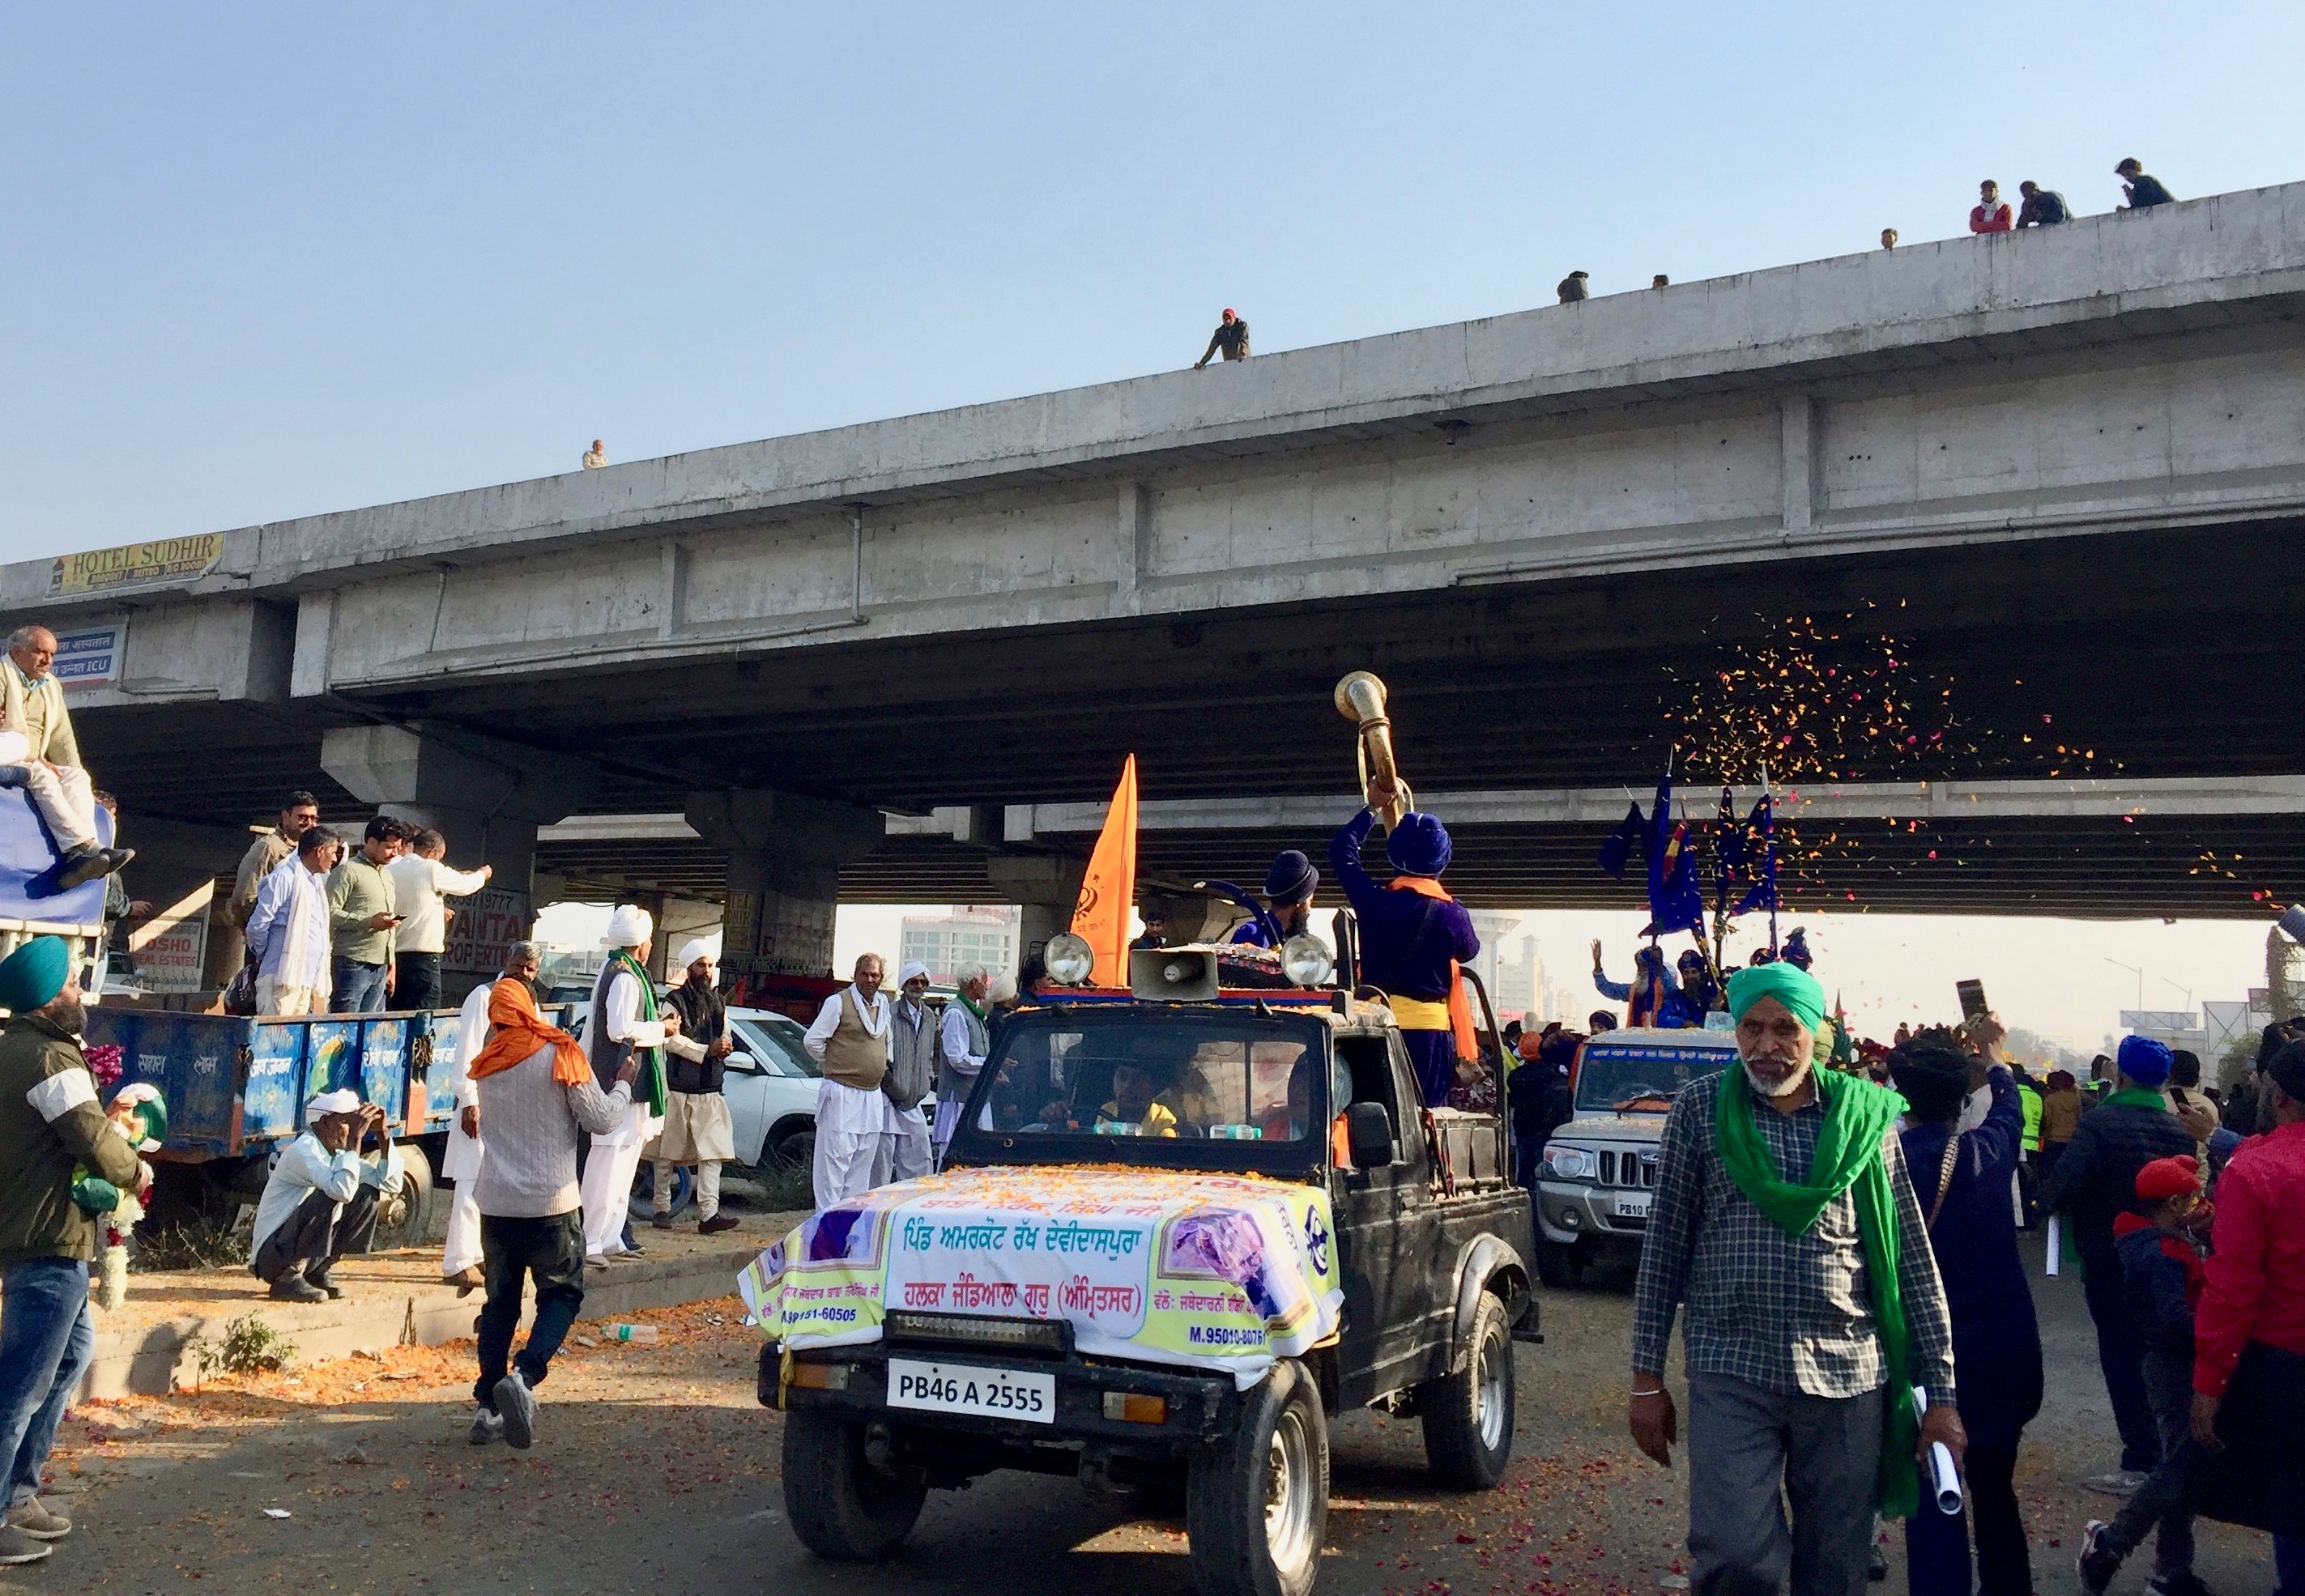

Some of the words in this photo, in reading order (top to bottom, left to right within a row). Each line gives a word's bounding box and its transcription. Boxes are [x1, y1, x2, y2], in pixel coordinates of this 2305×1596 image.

[73, 547, 134, 575] HOTEL
[141, 534, 215, 565] SUDHIR
[87, 659, 108, 672] ICU
[147, 937, 191, 952] OSHO
[159, 955, 196, 966] ESTATES
[1620, 1203, 1643, 1215] PB10
[903, 1217, 935, 1251] ਪਿੰਡ
[939, 1216, 1008, 1251] ਅਮਰਕੋਟ
[1014, 1219, 1040, 1251] ਰੱਖ
[1046, 1219, 1142, 1262] ਦੇਵੀਦਾਸਪੁਰਾ
[904, 1283, 946, 1308] ਹਲਕਾ
[952, 1271, 1017, 1309] ਜੰਡਿਆਲਾ
[900, 1375, 958, 1402] PB46
[962, 1381, 979, 1405] A
[986, 1383, 1043, 1412] 2555
